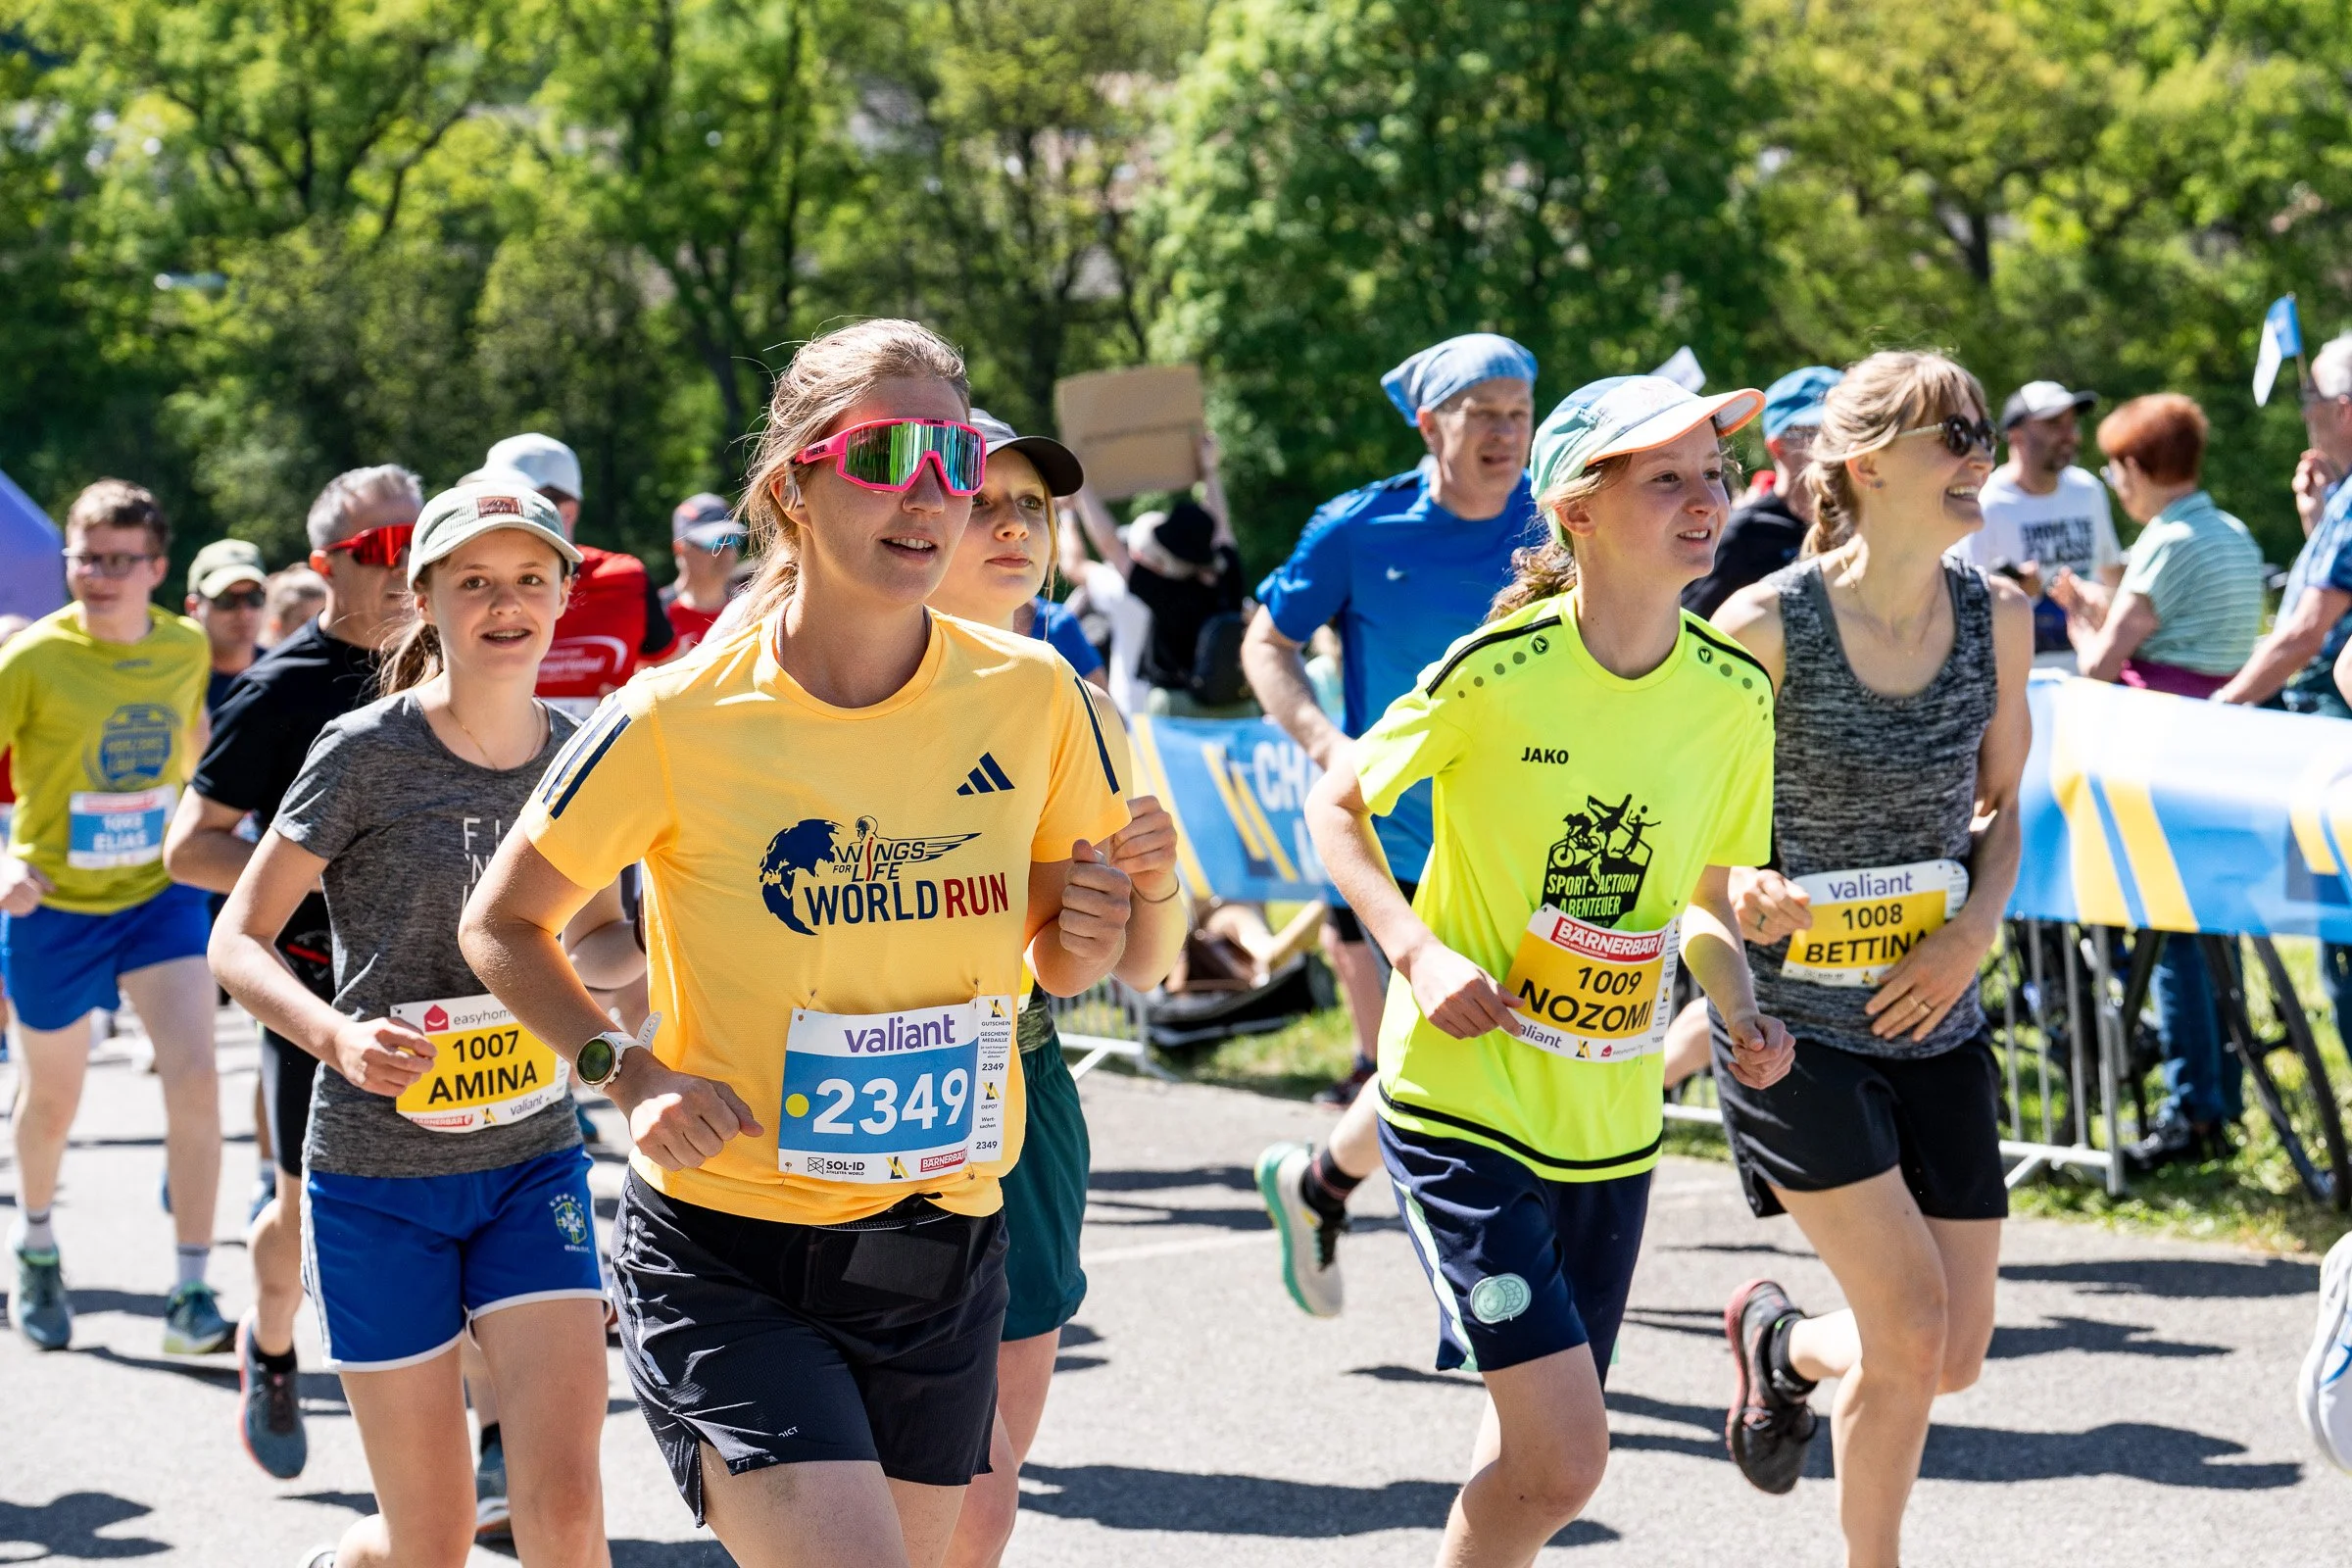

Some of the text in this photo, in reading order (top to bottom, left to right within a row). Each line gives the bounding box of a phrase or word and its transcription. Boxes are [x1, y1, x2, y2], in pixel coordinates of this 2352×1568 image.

[1521, 746, 1569, 765] JAKO
[835, 840, 926, 863] WINGS
[833, 861, 904, 882] FOR LIFE
[1546, 873, 1640, 896] SPORT ACTION
[804, 871, 1009, 926] WORLD RUN
[1829, 870, 1913, 901] valiant
[1559, 895, 1622, 918] ABENTEUER
[1841, 903, 1903, 930] 1008
[1557, 920, 1660, 956] BÄRNERBÄR
[1578, 966, 1642, 996] 1009
[454, 1007, 512, 1026] easyhom
[1519, 978, 1653, 1033] NOZOMI
[453, 1029, 519, 1063] 1007
[844, 1013, 956, 1054] valiant
[1519, 1023, 1563, 1049] aliant
[981, 1062, 1004, 1071] 2349
[427, 1059, 538, 1105] AMINA
[510, 1094, 544, 1116] valiant
[812, 1067, 969, 1136] 2349
[976, 1141, 998, 1150] 2349
[826, 1160, 865, 1171] SOL-ID
